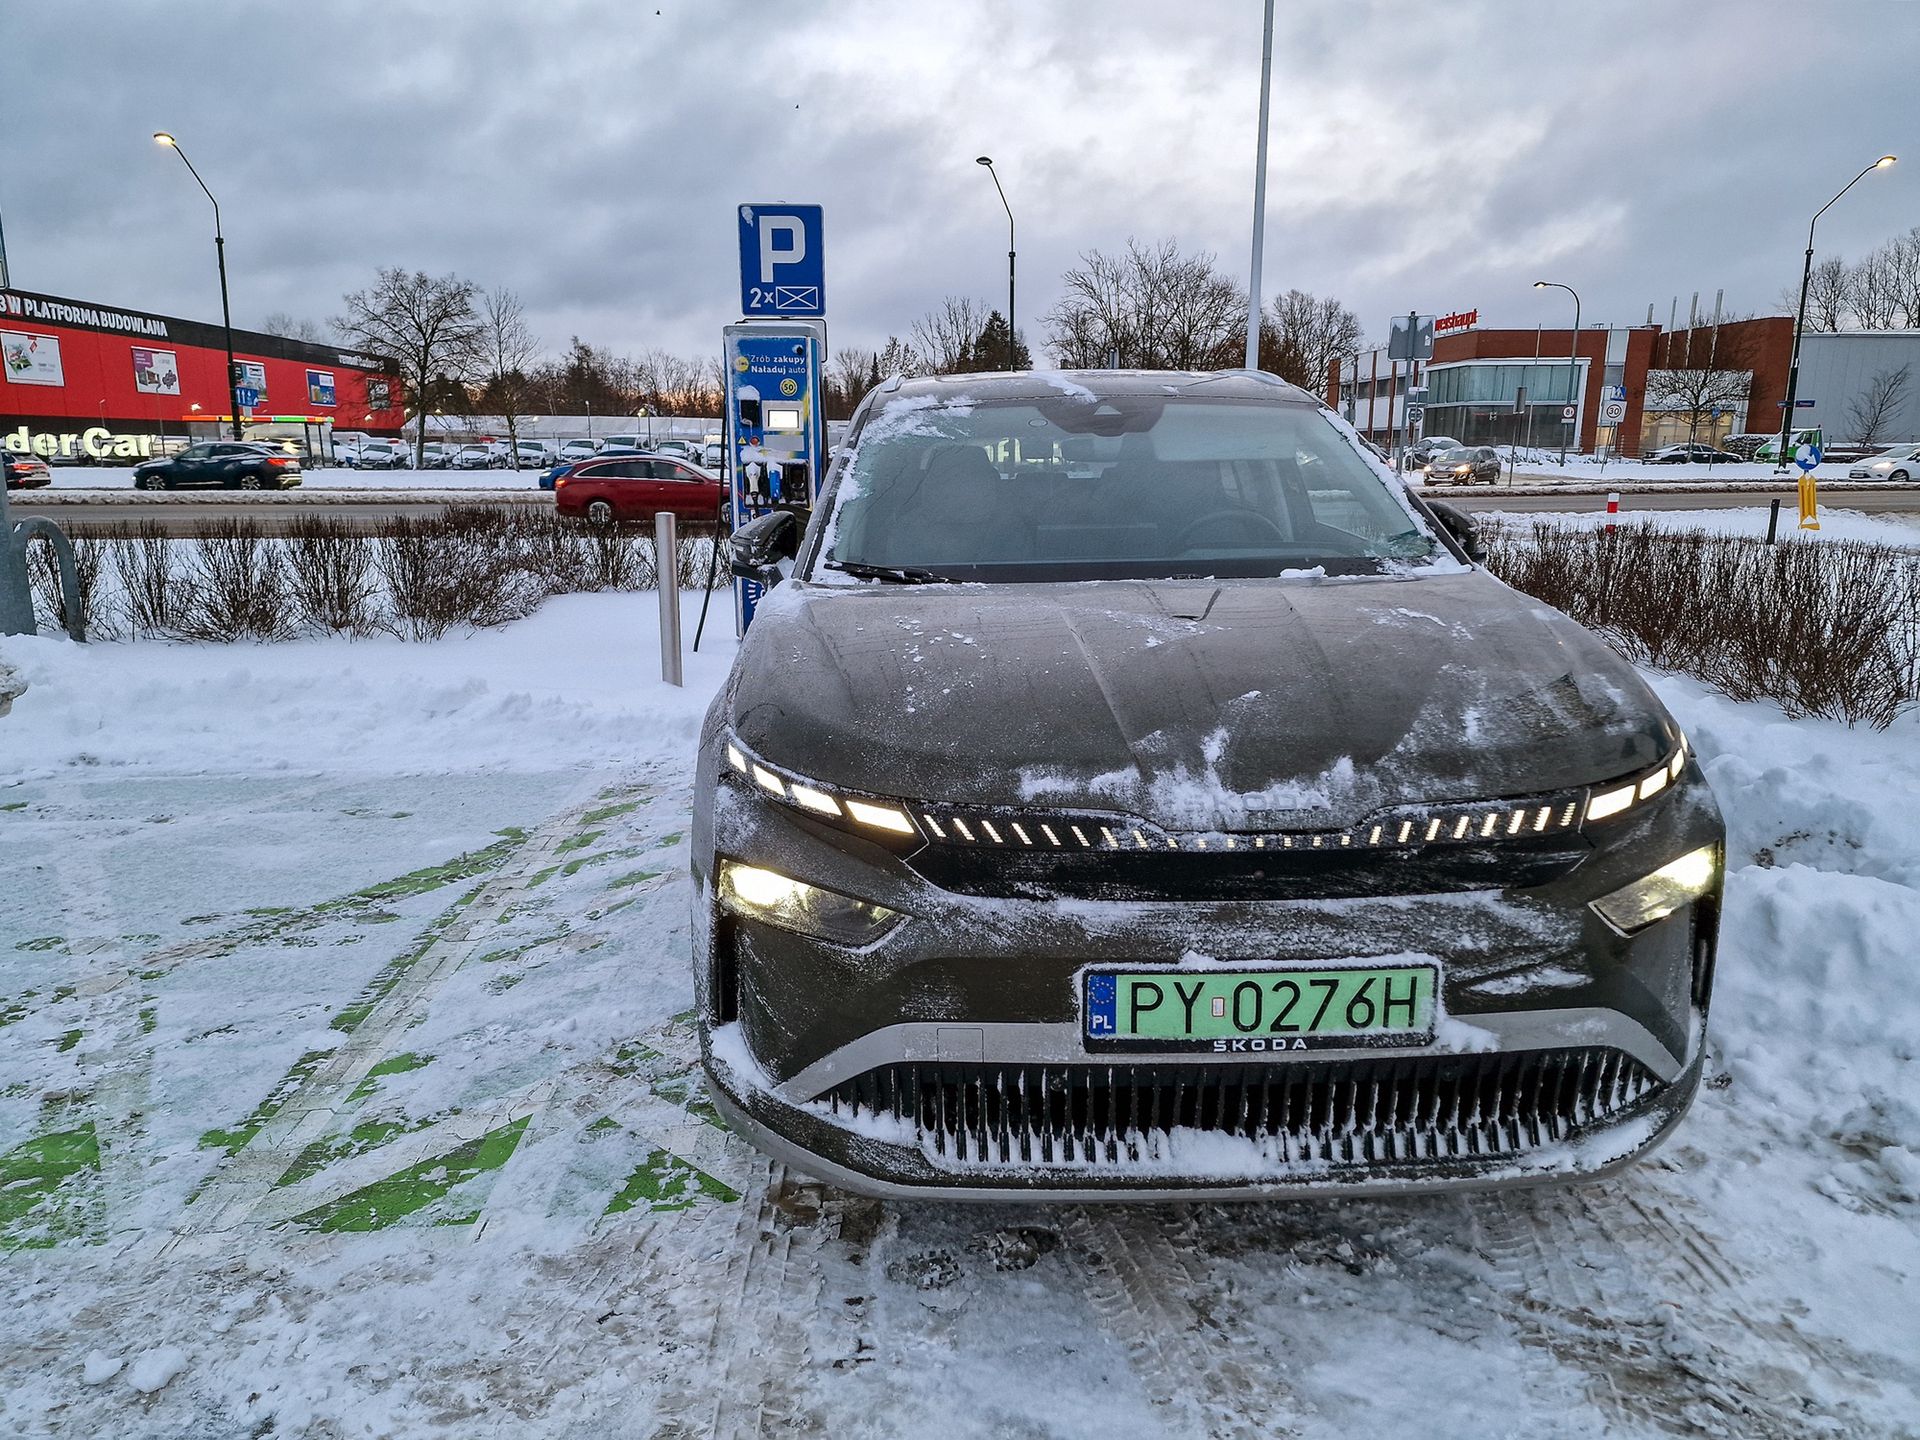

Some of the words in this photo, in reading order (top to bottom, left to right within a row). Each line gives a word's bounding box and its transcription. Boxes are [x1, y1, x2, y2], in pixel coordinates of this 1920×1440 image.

[759, 215, 806, 283] P
[24, 298, 100, 326] PLATFORMA
[100, 311, 168, 337] BUDOWLANA
[750, 355, 771, 363] Zrób
[773, 355, 805, 365] zakupy
[751, 365, 786, 375] Naładuj
[1608, 407, 1620, 415] 30
[1131, 981, 1206, 1034] PY
[1232, 976, 1418, 1033] 0276H
[1092, 1015, 1112, 1029] PL
